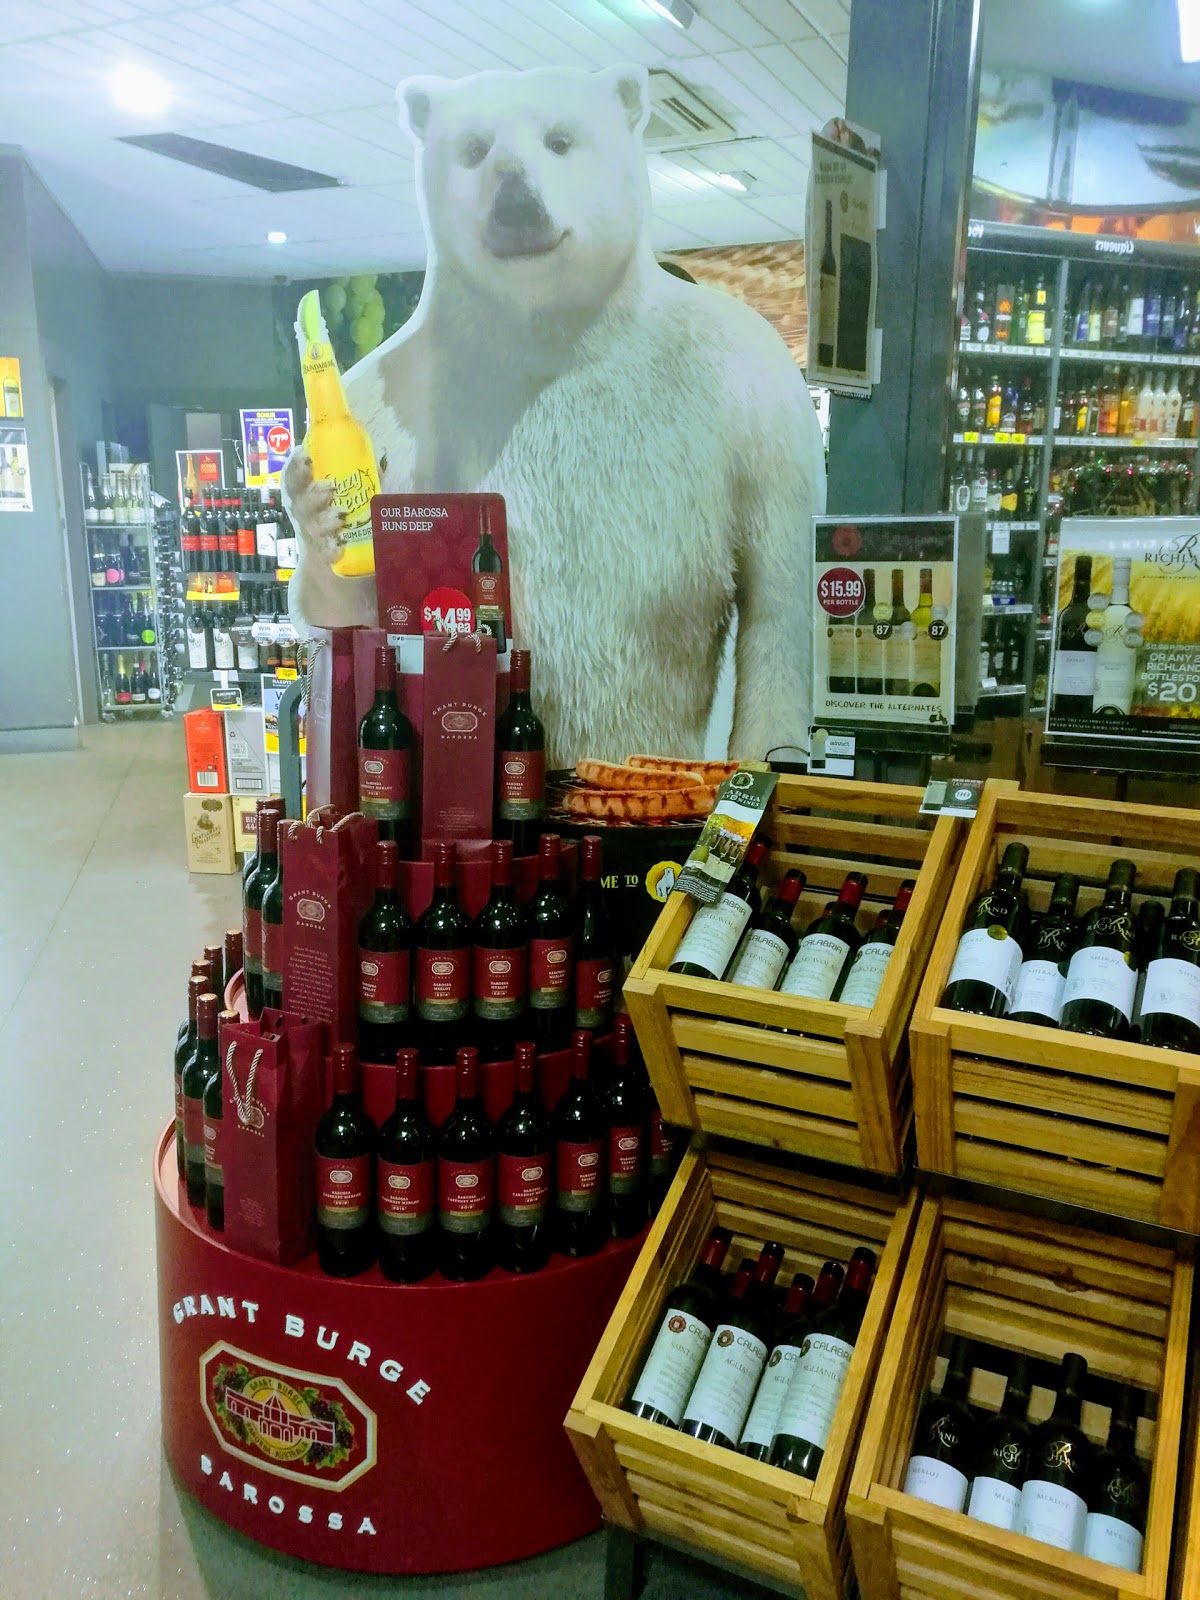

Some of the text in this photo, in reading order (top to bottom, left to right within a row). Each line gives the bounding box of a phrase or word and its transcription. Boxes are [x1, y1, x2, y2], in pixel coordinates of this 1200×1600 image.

[380, 506, 449, 518] OUR BAROSSA
[381, 521, 433, 531] RUNS DEEP
[820, 580, 862, 598] $15.99
[876, 625, 889, 635] 87
[931, 625, 945, 636] 87
[1150, 652, 1166, 661] OR
[1167, 653, 1192, 662] ANY
[1141, 672, 1184, 682] BOTTLES
[1147, 682, 1197, 703] $20
[825, 699, 942, 713] DISCOVER THE ALTERNATES
[624, 875, 639, 887] TO
[721, 898, 747, 917] ABRIA
[802, 939, 843, 954] CALABRIA
[172, 1294, 431, 1405] GRANT BURGE
[201, 1454, 377, 1535] BAROSSA
